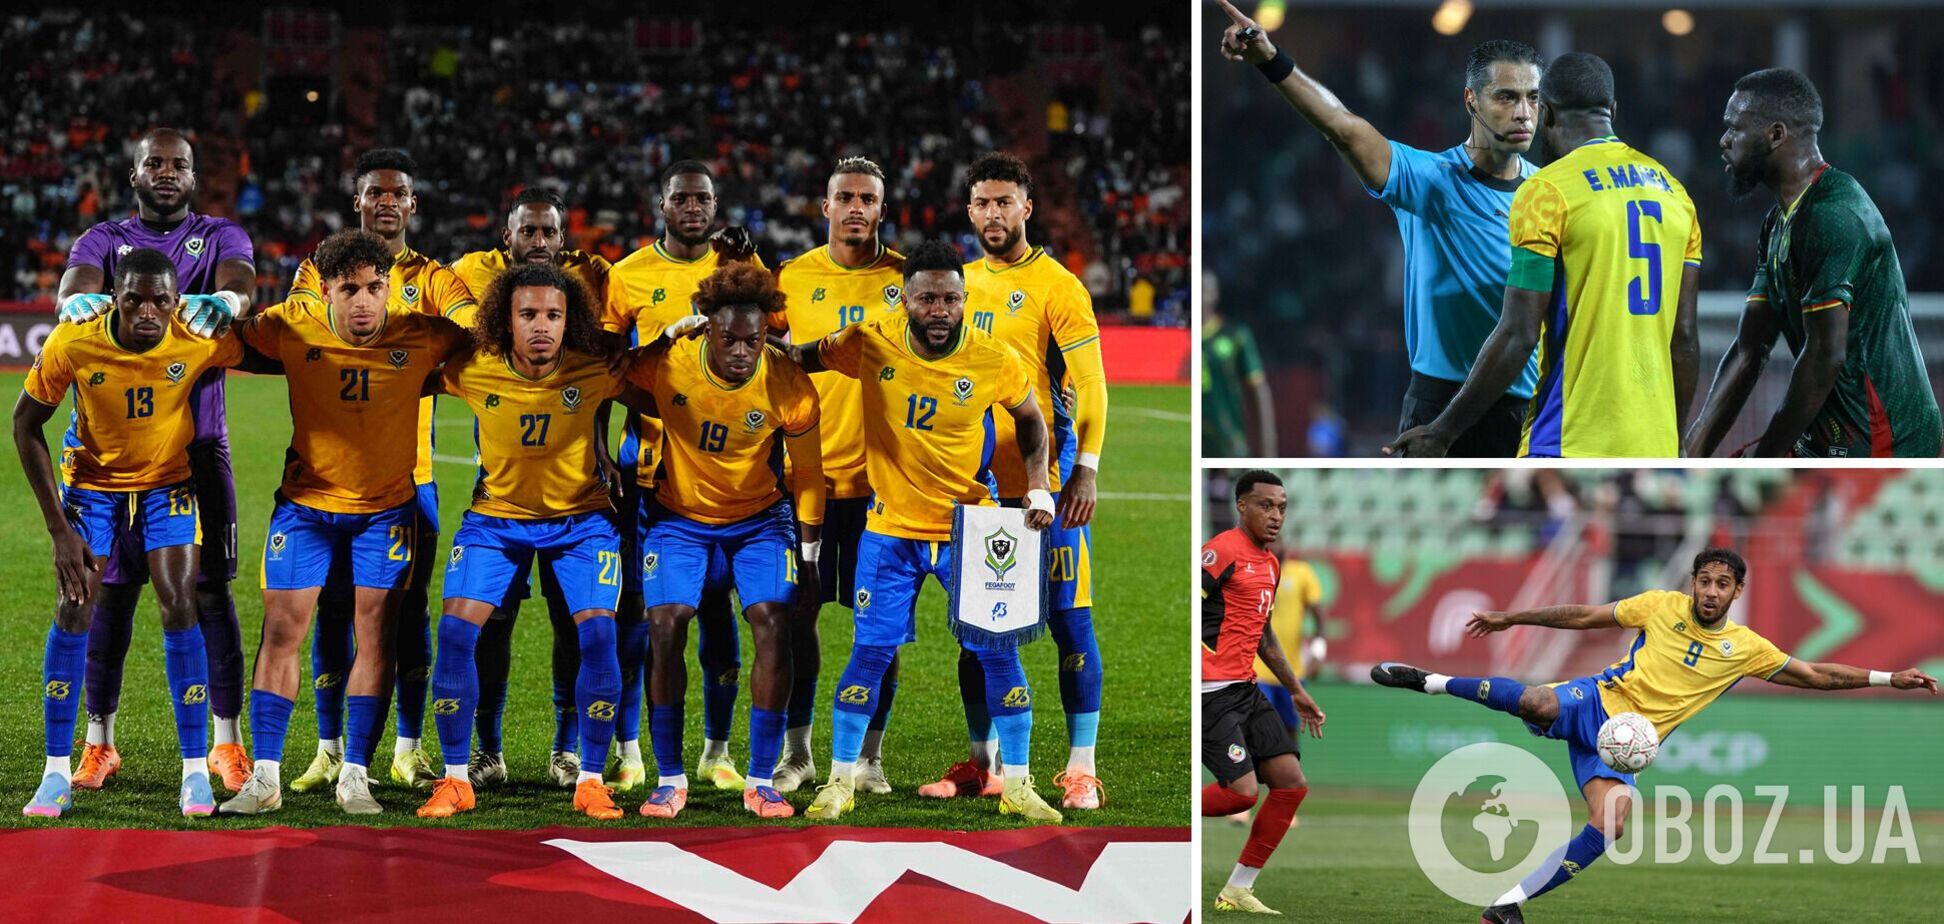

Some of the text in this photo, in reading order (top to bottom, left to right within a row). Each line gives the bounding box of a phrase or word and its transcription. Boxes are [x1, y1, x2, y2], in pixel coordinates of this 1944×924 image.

[1626, 200, 1662, 315] 5
[341, 368, 369, 401] 21
[124, 386, 154, 419] 13
[904, 393, 938, 431] 12
[520, 413, 552, 446] 27
[699, 420, 729, 452] 19
[389, 525, 412, 561] 21
[598, 550, 620, 586] 27
[1049, 546, 1075, 581] 20
[1683, 640, 1703, 667] 9
